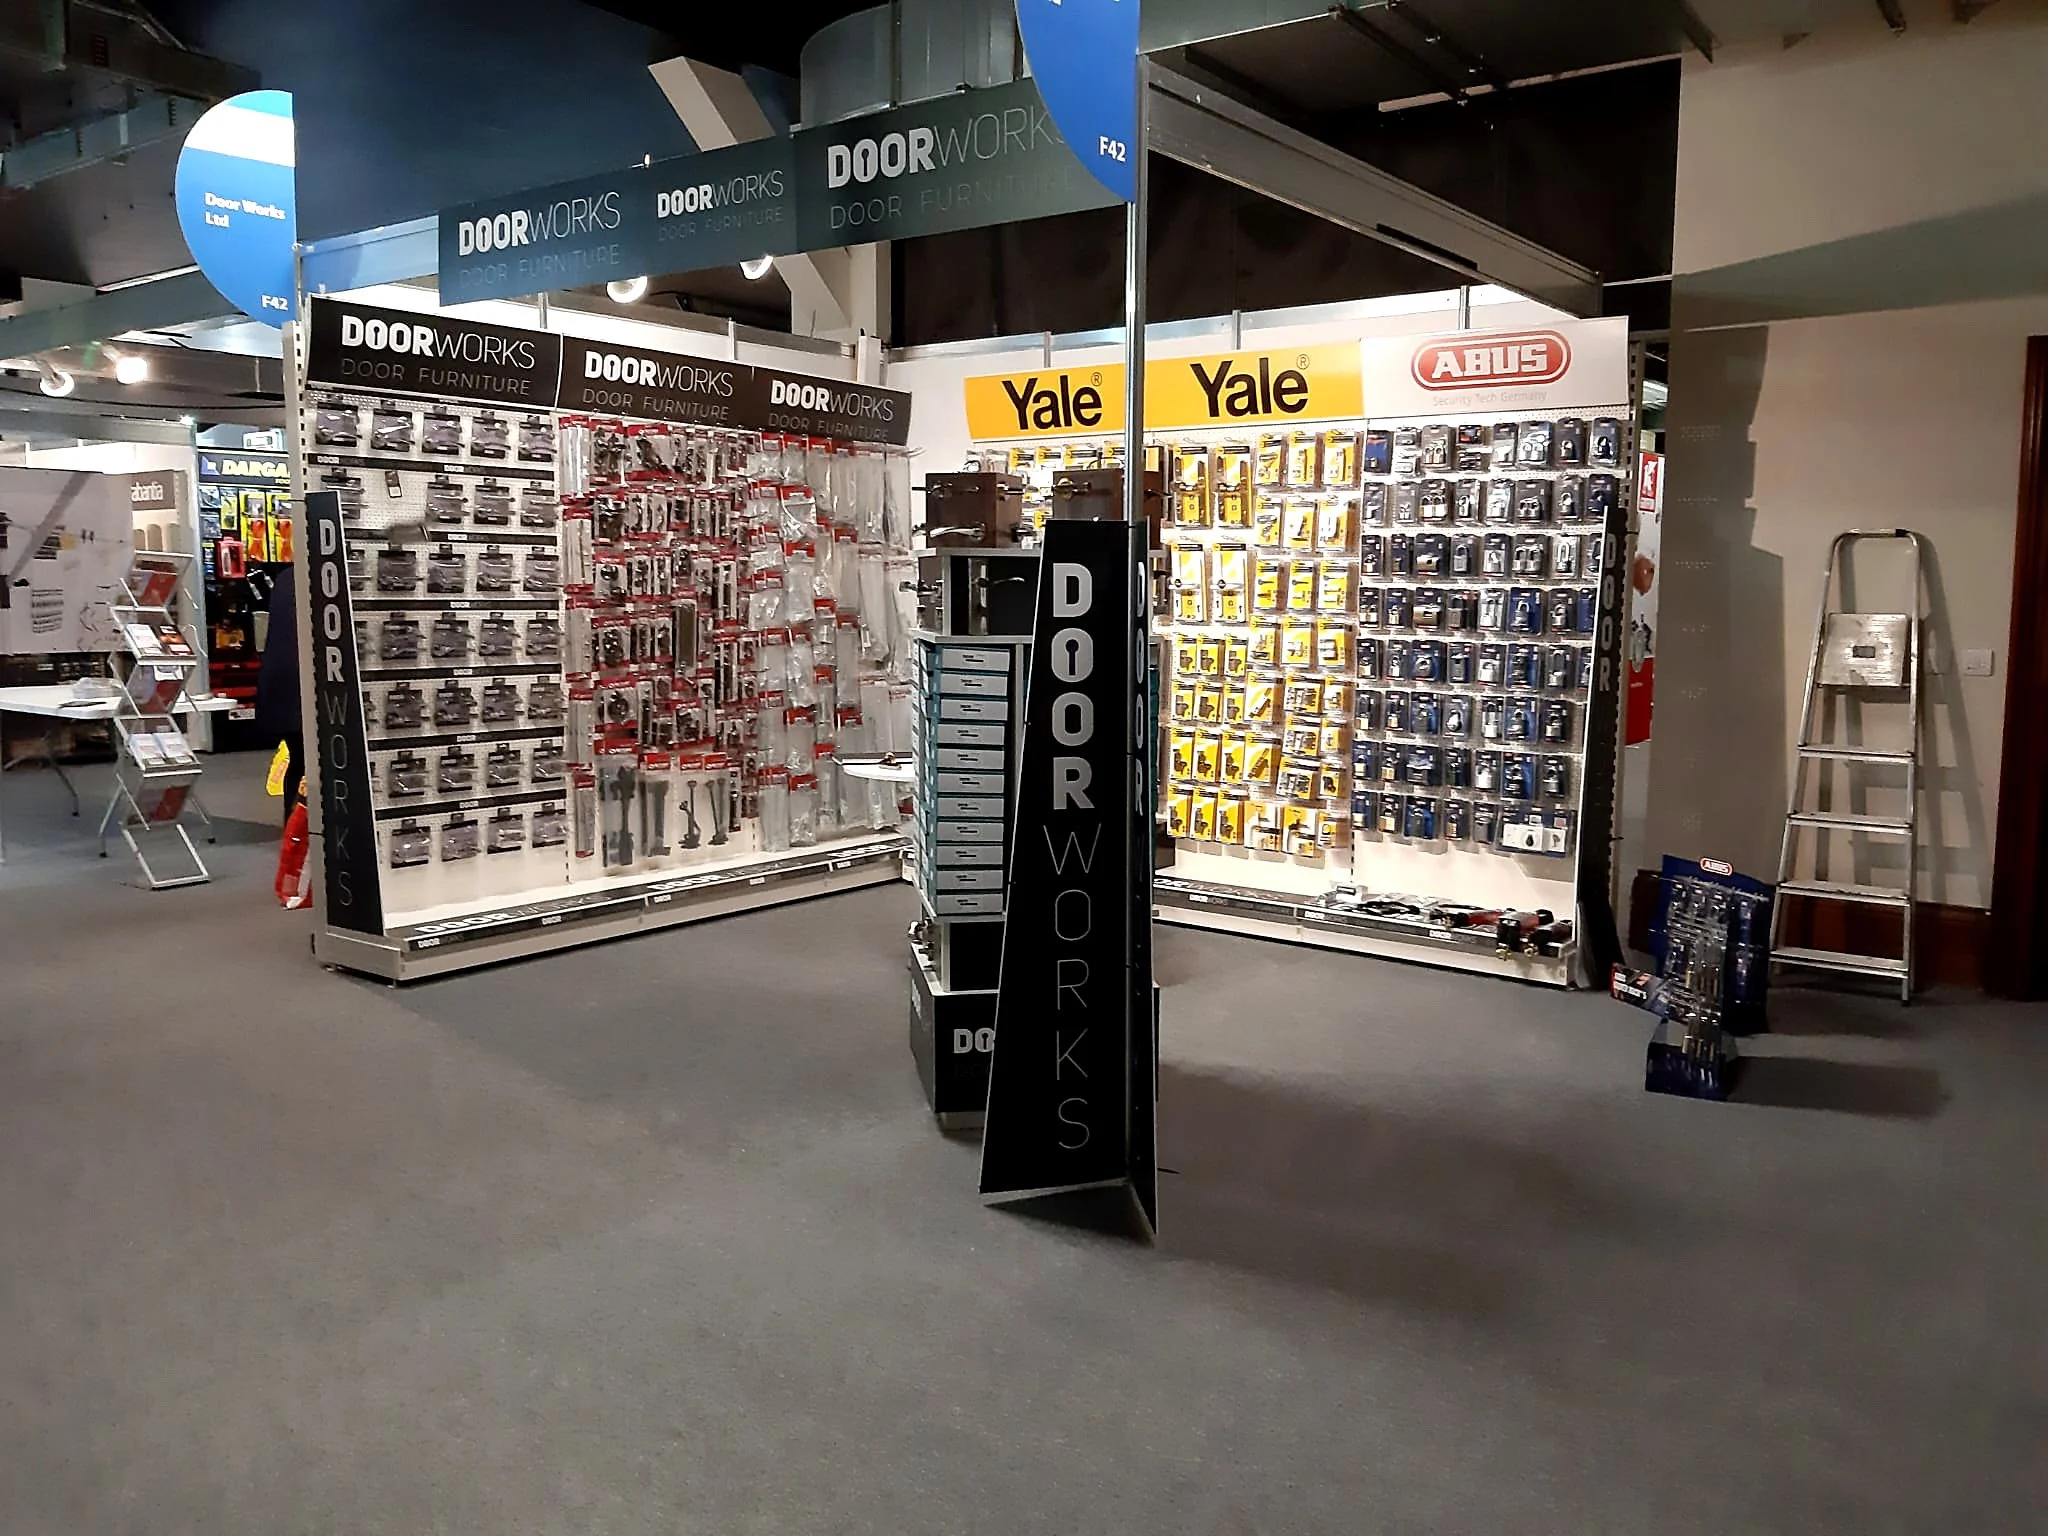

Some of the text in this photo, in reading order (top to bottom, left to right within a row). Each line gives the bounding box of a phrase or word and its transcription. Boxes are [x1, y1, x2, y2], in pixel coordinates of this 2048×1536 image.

[828, 104, 1065, 189] DOORWORK
[1099, 135, 1126, 163] F42
[205, 192, 287, 221] Door Works
[658, 170, 785, 219] DOORWORKS
[205, 212, 230, 228] Ltd
[458, 191, 621, 256] DOORWORKS
[830, 196, 902, 230] DOOR
[261, 294, 289, 311] F42
[341, 313, 536, 370] DOORWORKS
[341, 358, 532, 396] DOOR FURNITURE
[584, 350, 733, 398] DOORWORKS
[1431, 343, 1548, 379] ABUS
[583, 387, 729, 421] DOOR FURNITURE
[770, 379, 894, 421] DOORWORKS
[1433, 396, 1472, 408] Security
[1500, 391, 1548, 403] Germany
[769, 412, 889, 443] DOOR FURNITURE
[222, 459, 290, 478] DARGA
[131, 481, 163, 502] abantia
[1043, 562, 1101, 1151] DOORWORKS
